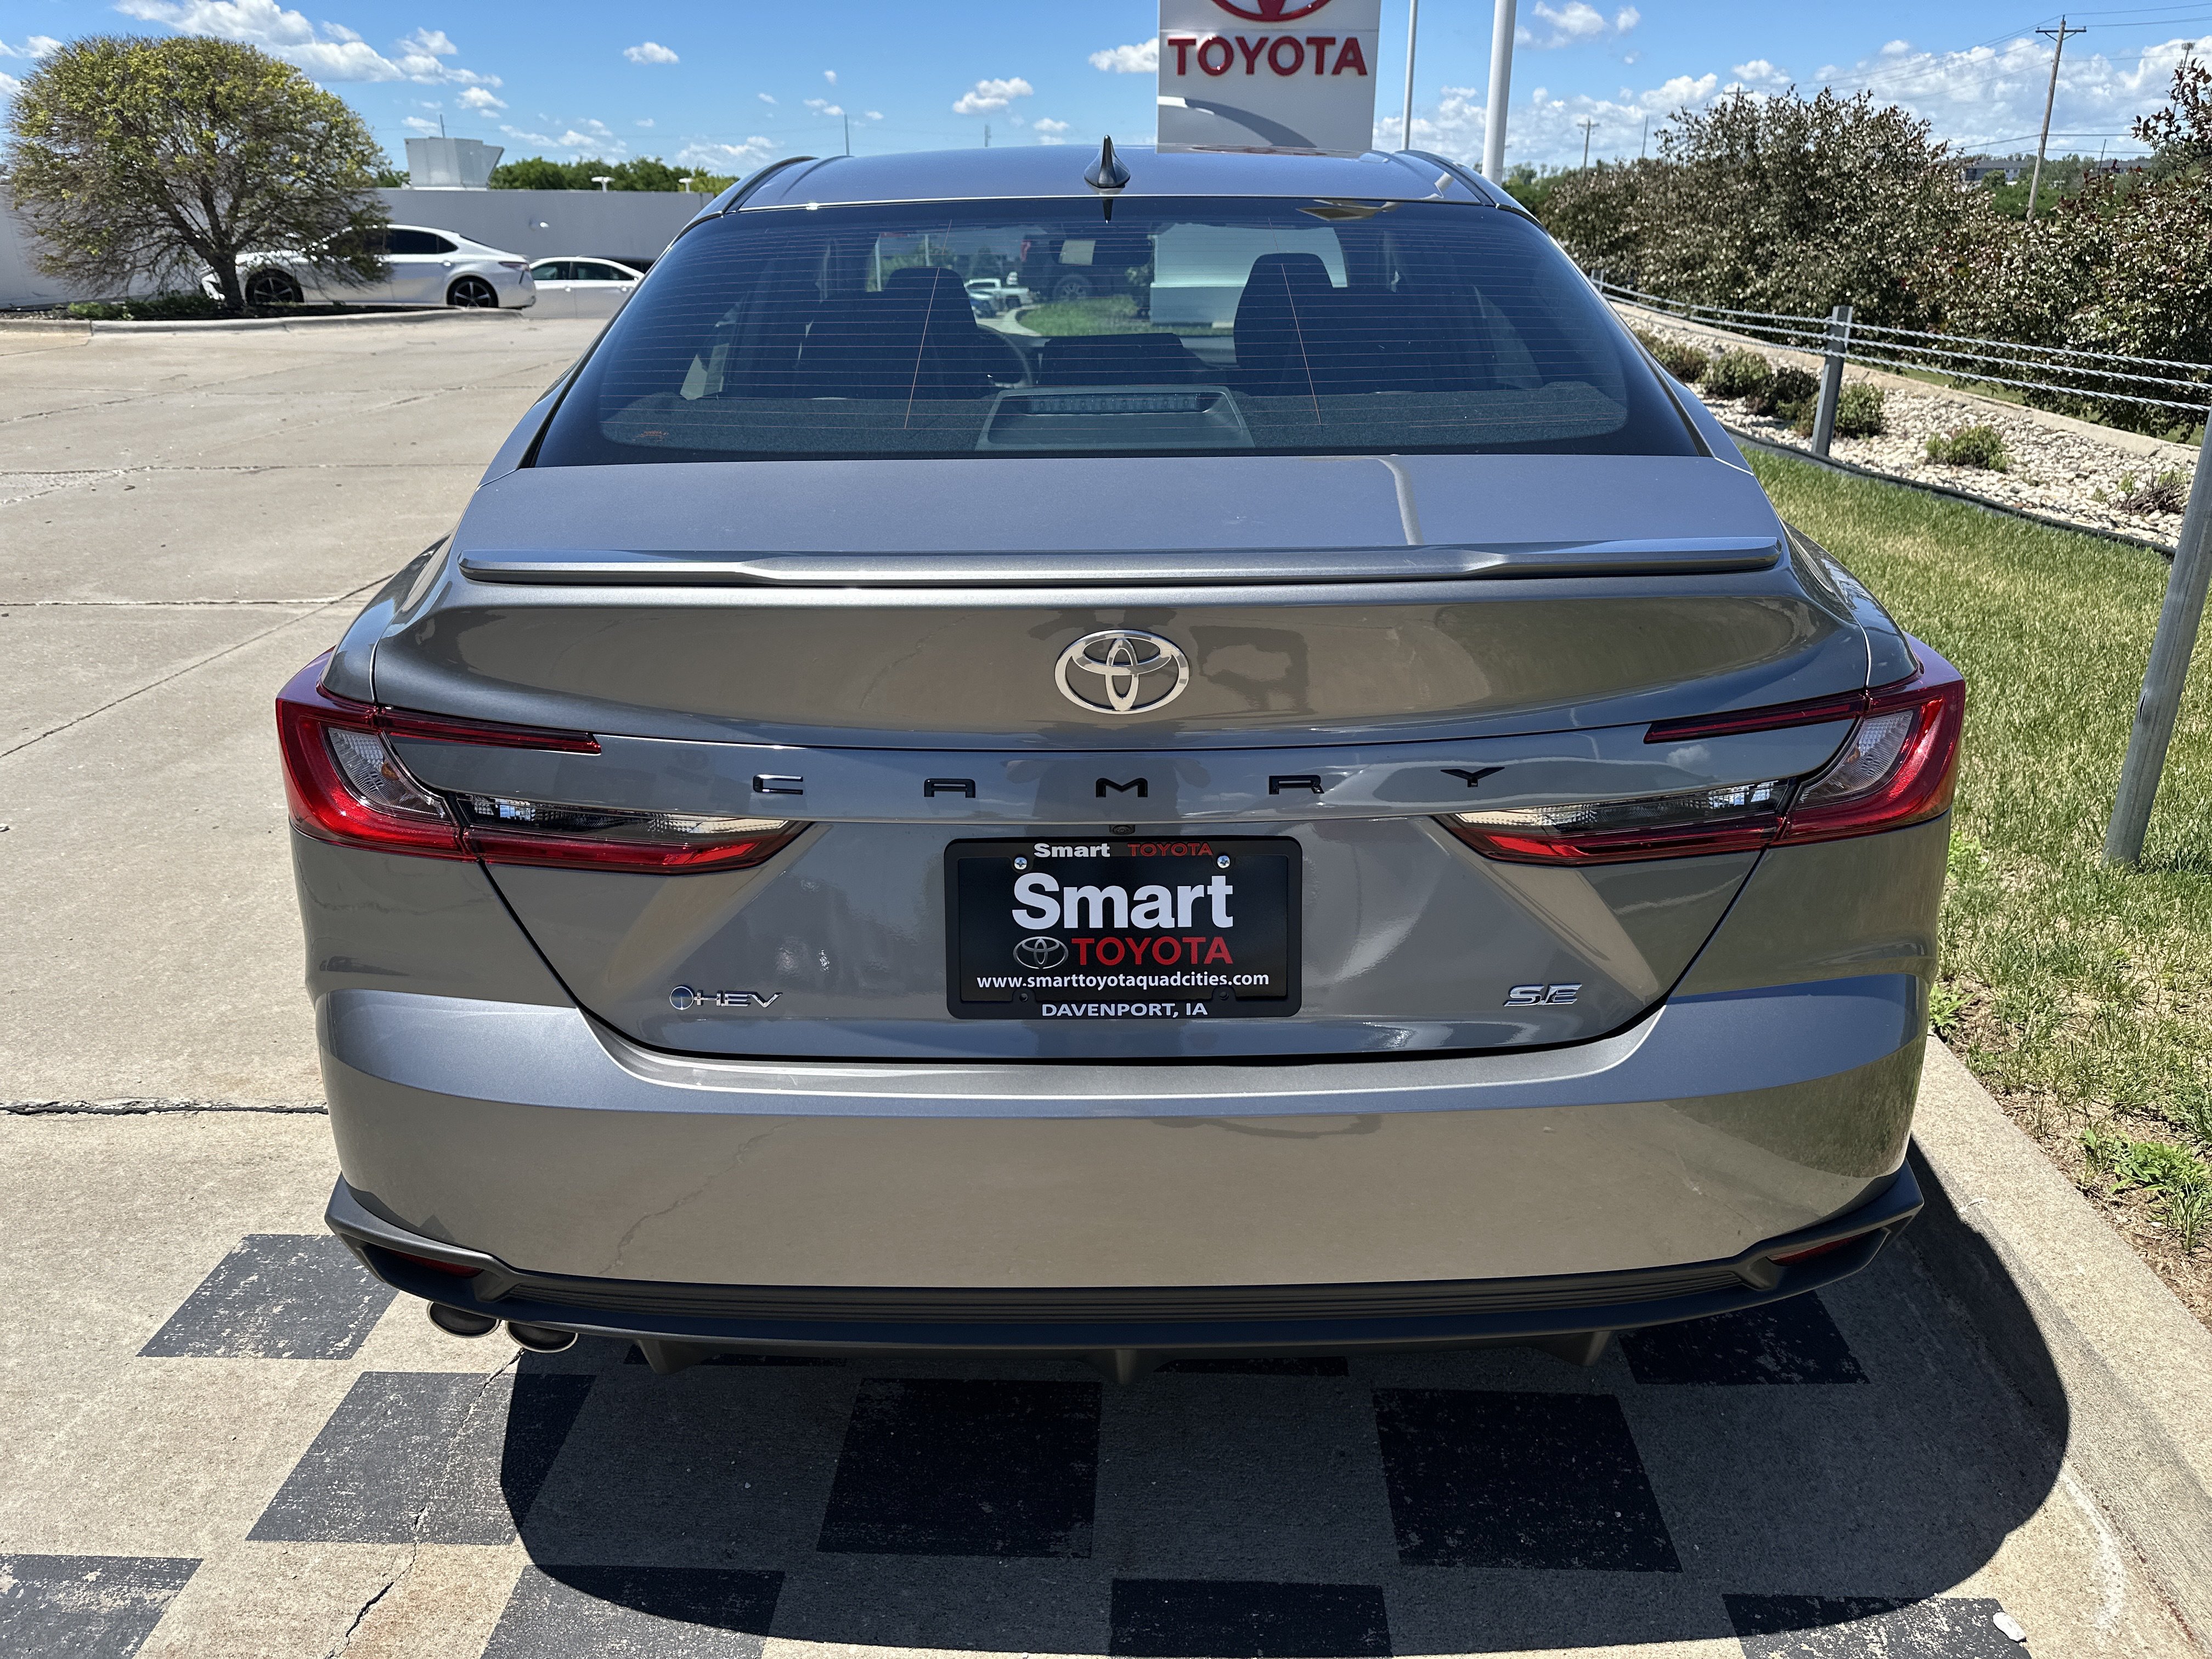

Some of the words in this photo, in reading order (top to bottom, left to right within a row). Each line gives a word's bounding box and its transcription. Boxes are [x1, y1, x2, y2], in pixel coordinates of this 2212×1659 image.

[1167, 36, 1368, 76] TOYOTA
[753, 766, 1505, 798] CAMRY
[1034, 843, 1110, 857] Smart
[1127, 843, 1213, 856] TOYOTA
[1012, 872, 1233, 929] Smart
[1071, 936, 1233, 966] TOYOTA
[977, 972, 1269, 990] www.smarttoyotaquadcities.com
[1502, 983, 1583, 1007] SE
[1042, 1003, 1179, 1018] DAVENPORT,
[1186, 1003, 1208, 1015] IA
